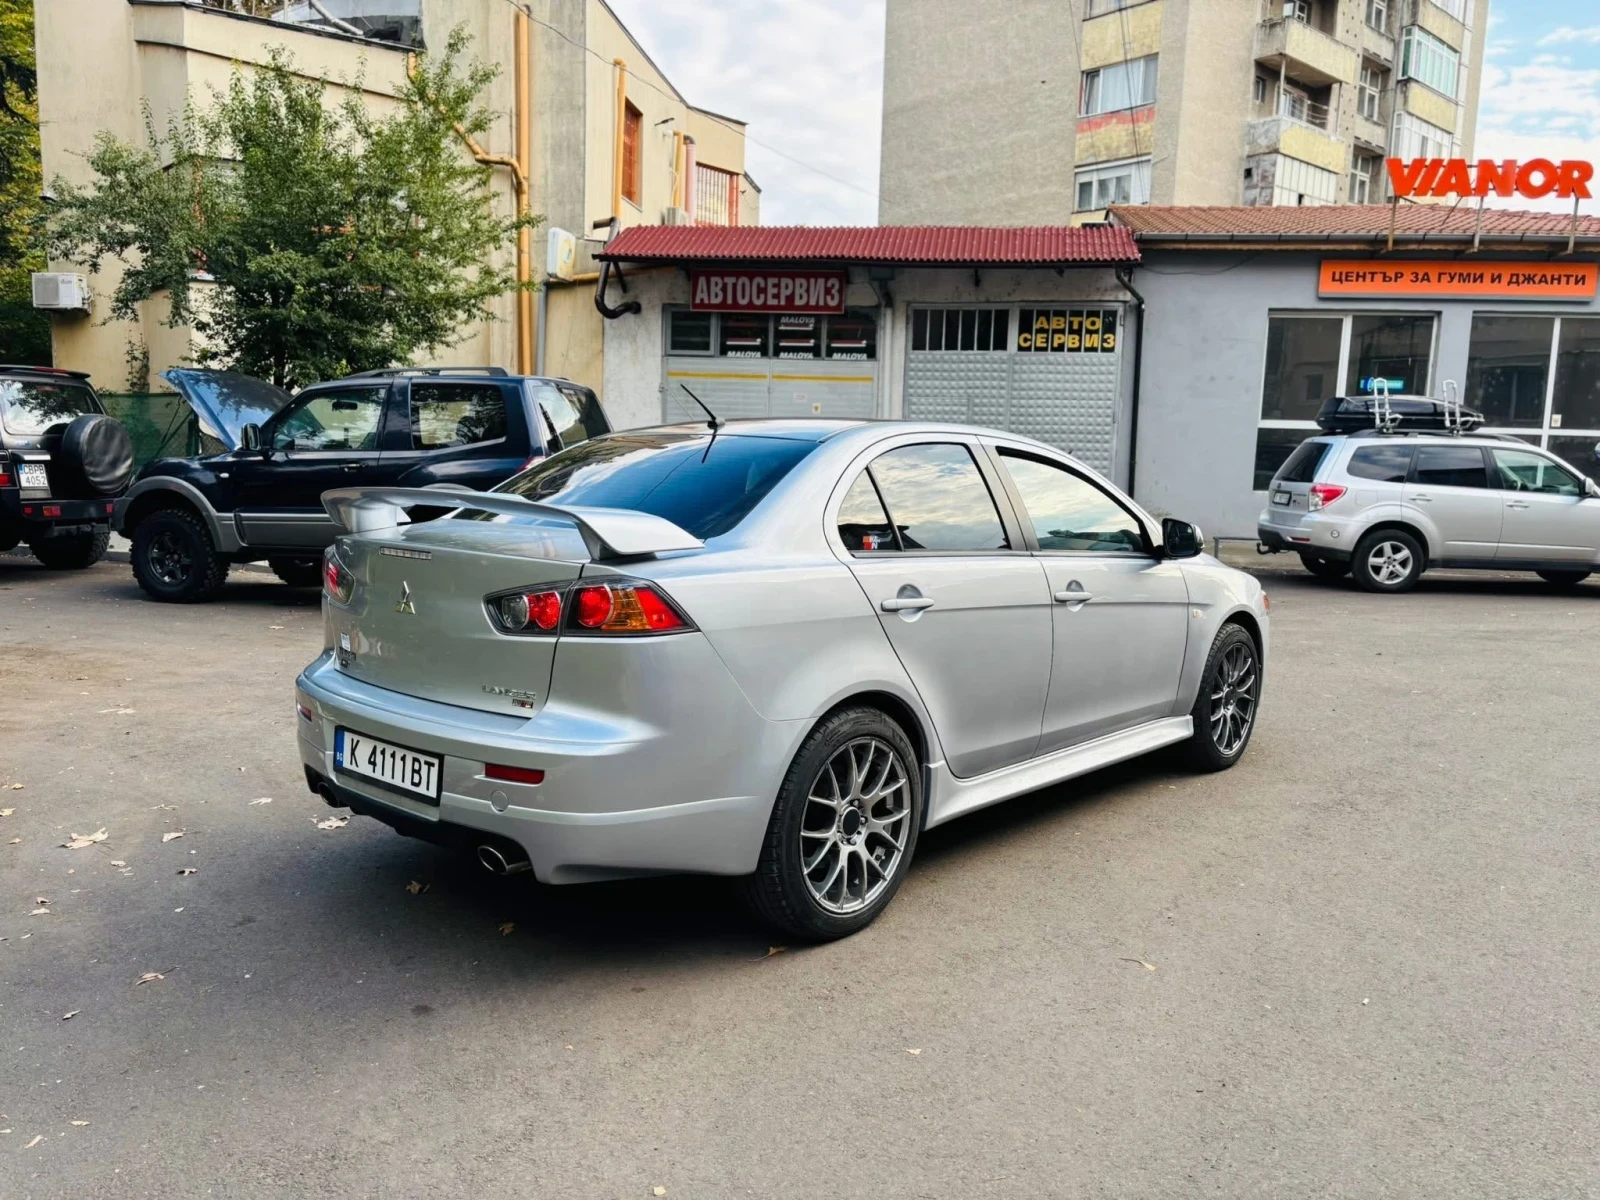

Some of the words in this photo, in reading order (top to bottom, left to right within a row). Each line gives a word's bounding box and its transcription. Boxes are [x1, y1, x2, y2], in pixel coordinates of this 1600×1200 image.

[1385, 157, 1594, 199] VIANOR
[1331, 270, 1404, 284] ЦЕНТЪР
[1410, 271, 1431, 283] ЗА
[1437, 272, 1484, 284] ГУМИ
[1490, 272, 1502, 284] И
[1507, 272, 1587, 287] ДЖАНТИ
[694, 276, 840, 306] АВТОСЕРВИЗ
[780, 316, 815, 324] MALOYA
[1035, 316, 1101, 330] АВТО
[1018, 333, 1116, 348] СЕРВИЗ
[727, 351, 761, 359] MALOYA
[779, 352, 813, 360] MALOYA
[832, 352, 867, 360] MALOYA
[25, 476, 47, 485] 4052
[350, 737, 361, 768] K
[367, 744, 435, 792] 4111BT
